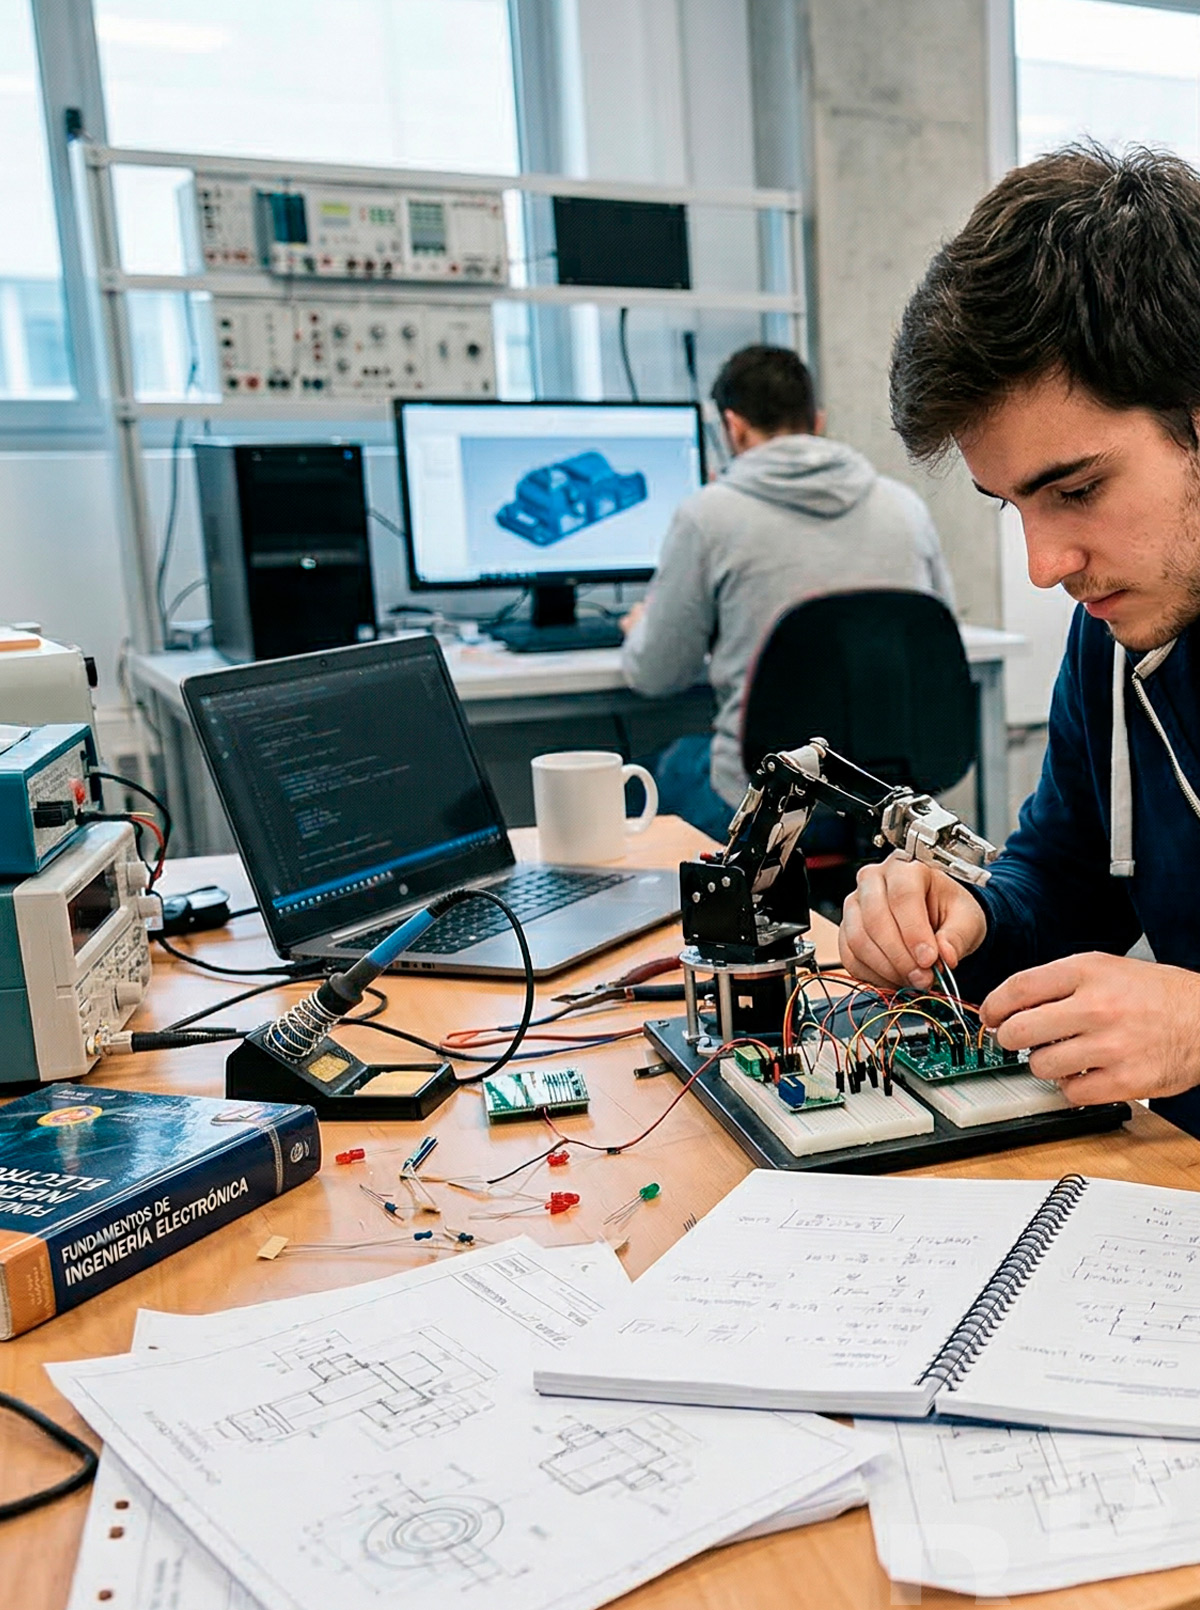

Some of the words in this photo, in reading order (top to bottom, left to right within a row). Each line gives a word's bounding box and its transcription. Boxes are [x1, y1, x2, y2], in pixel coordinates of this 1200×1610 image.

[61, 1208, 152, 1264] FUNDAMENTOS
[155, 1197, 170, 1218] DE
[65, 1225, 153, 1287] INGENIERÍA
[156, 1177, 249, 1239] ELECTRÓNICA
